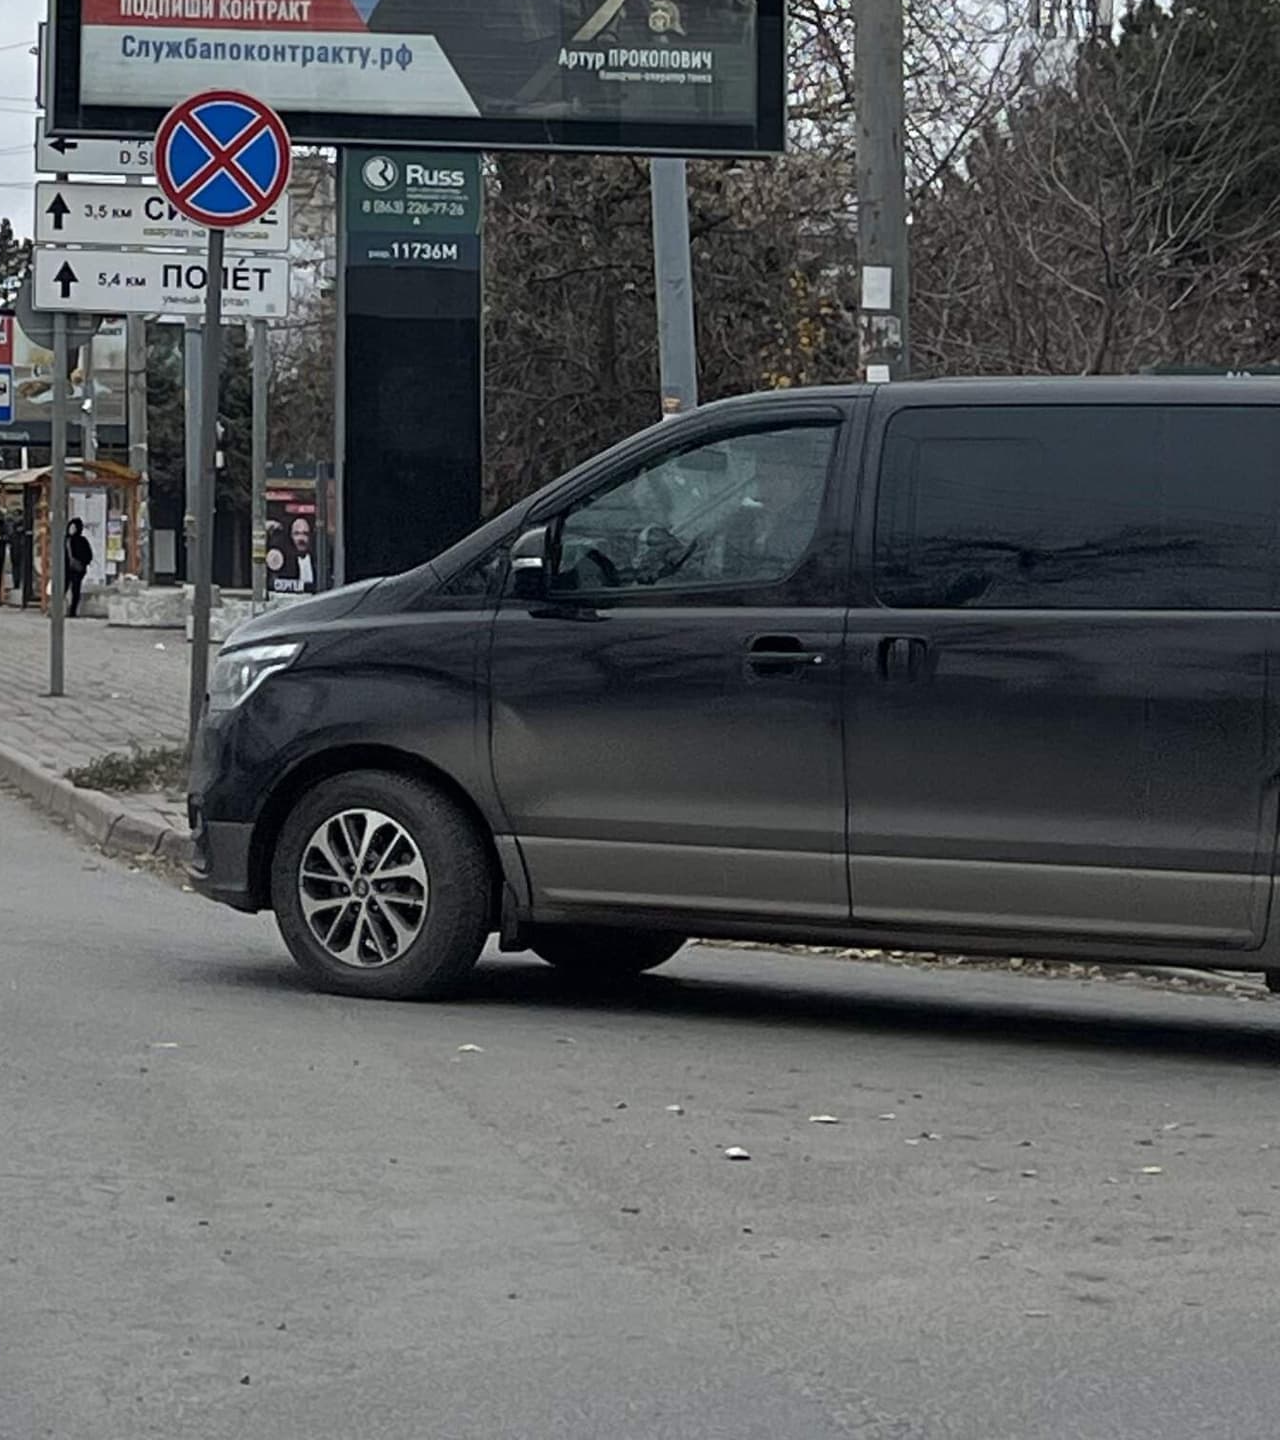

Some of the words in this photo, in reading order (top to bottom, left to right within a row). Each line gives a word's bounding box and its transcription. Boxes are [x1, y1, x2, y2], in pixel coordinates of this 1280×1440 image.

[219, 0, 312, 22] КОНТРАКТ
[122, 35, 414, 71] Службапоконтракту.рф
[558, 48, 606, 69] Артур
[608, 49, 713, 69] ПРОКОПОВИЧ
[406, 164, 464, 186] Russ
[84, 205, 107, 219] 3,5
[112, 209, 133, 219] км
[98, 273, 121, 287] 5,4
[126, 277, 146, 287] км
